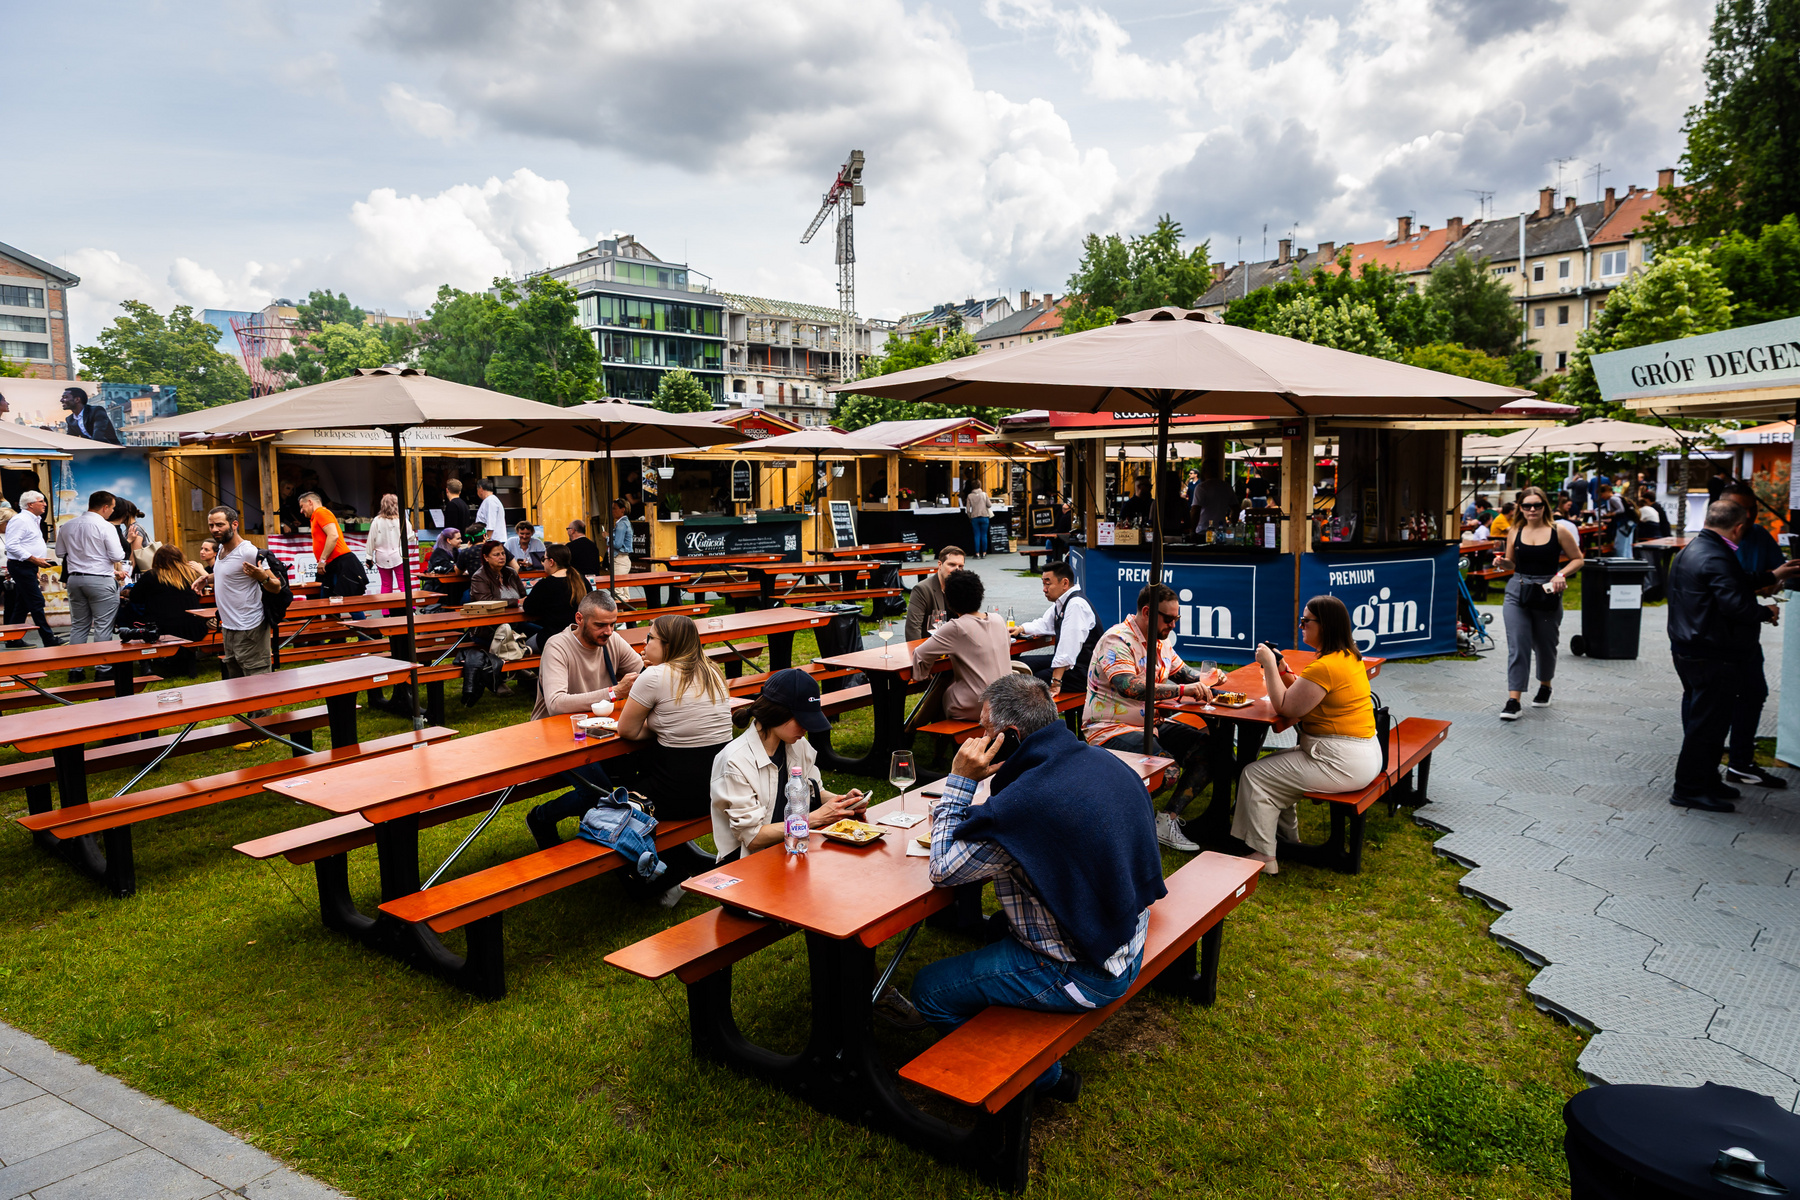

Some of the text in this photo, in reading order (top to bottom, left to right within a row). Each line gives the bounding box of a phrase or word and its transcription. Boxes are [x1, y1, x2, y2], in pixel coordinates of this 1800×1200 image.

[1631, 351, 1696, 388] GRÓF
[313, 429, 357, 439] Budapest
[1118, 568, 1174, 584] PREMM
[1329, 569, 1375, 586] PREMIUM
[1171, 588, 1246, 647] in.
[1352, 587, 1425, 653] gin.
